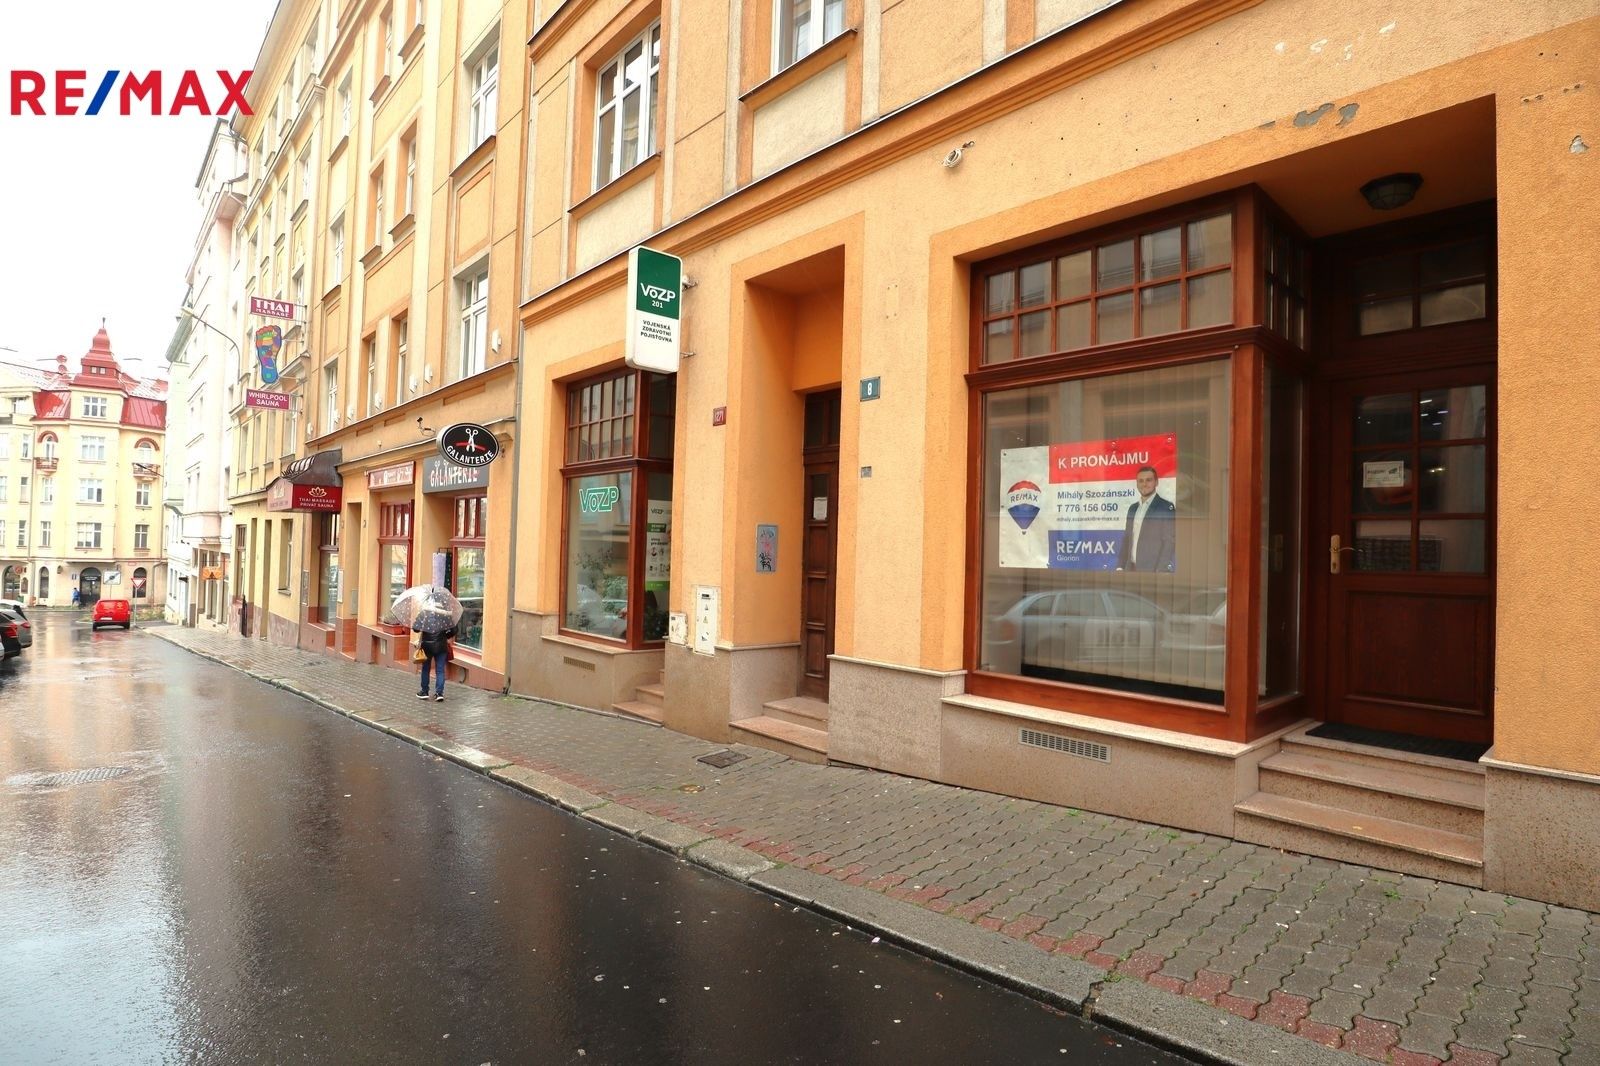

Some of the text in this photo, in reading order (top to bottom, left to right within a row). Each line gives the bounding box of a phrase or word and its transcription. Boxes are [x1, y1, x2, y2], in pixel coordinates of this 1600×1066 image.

[254, 298, 290, 313] THAI
[651, 300, 663, 309] 201
[867, 382, 873, 396] 8
[248, 391, 288, 402] WHIRLPOOL
[256, 399, 280, 407] SAUNA
[446, 445, 494, 465] GALANTERIE
[1058, 452, 1149, 469] K PRONÁJMU
[430, 460, 478, 487] GALANTERIE
[1010, 492, 1038, 503] RE/MAX
[1057, 488, 1135, 500] Mihály Szozánszki
[1065, 504, 1080, 512] 776
[1083, 503, 1099, 512] 156
[1101, 503, 1118, 512] 050
[1057, 541, 1115, 554] RE/MAX
